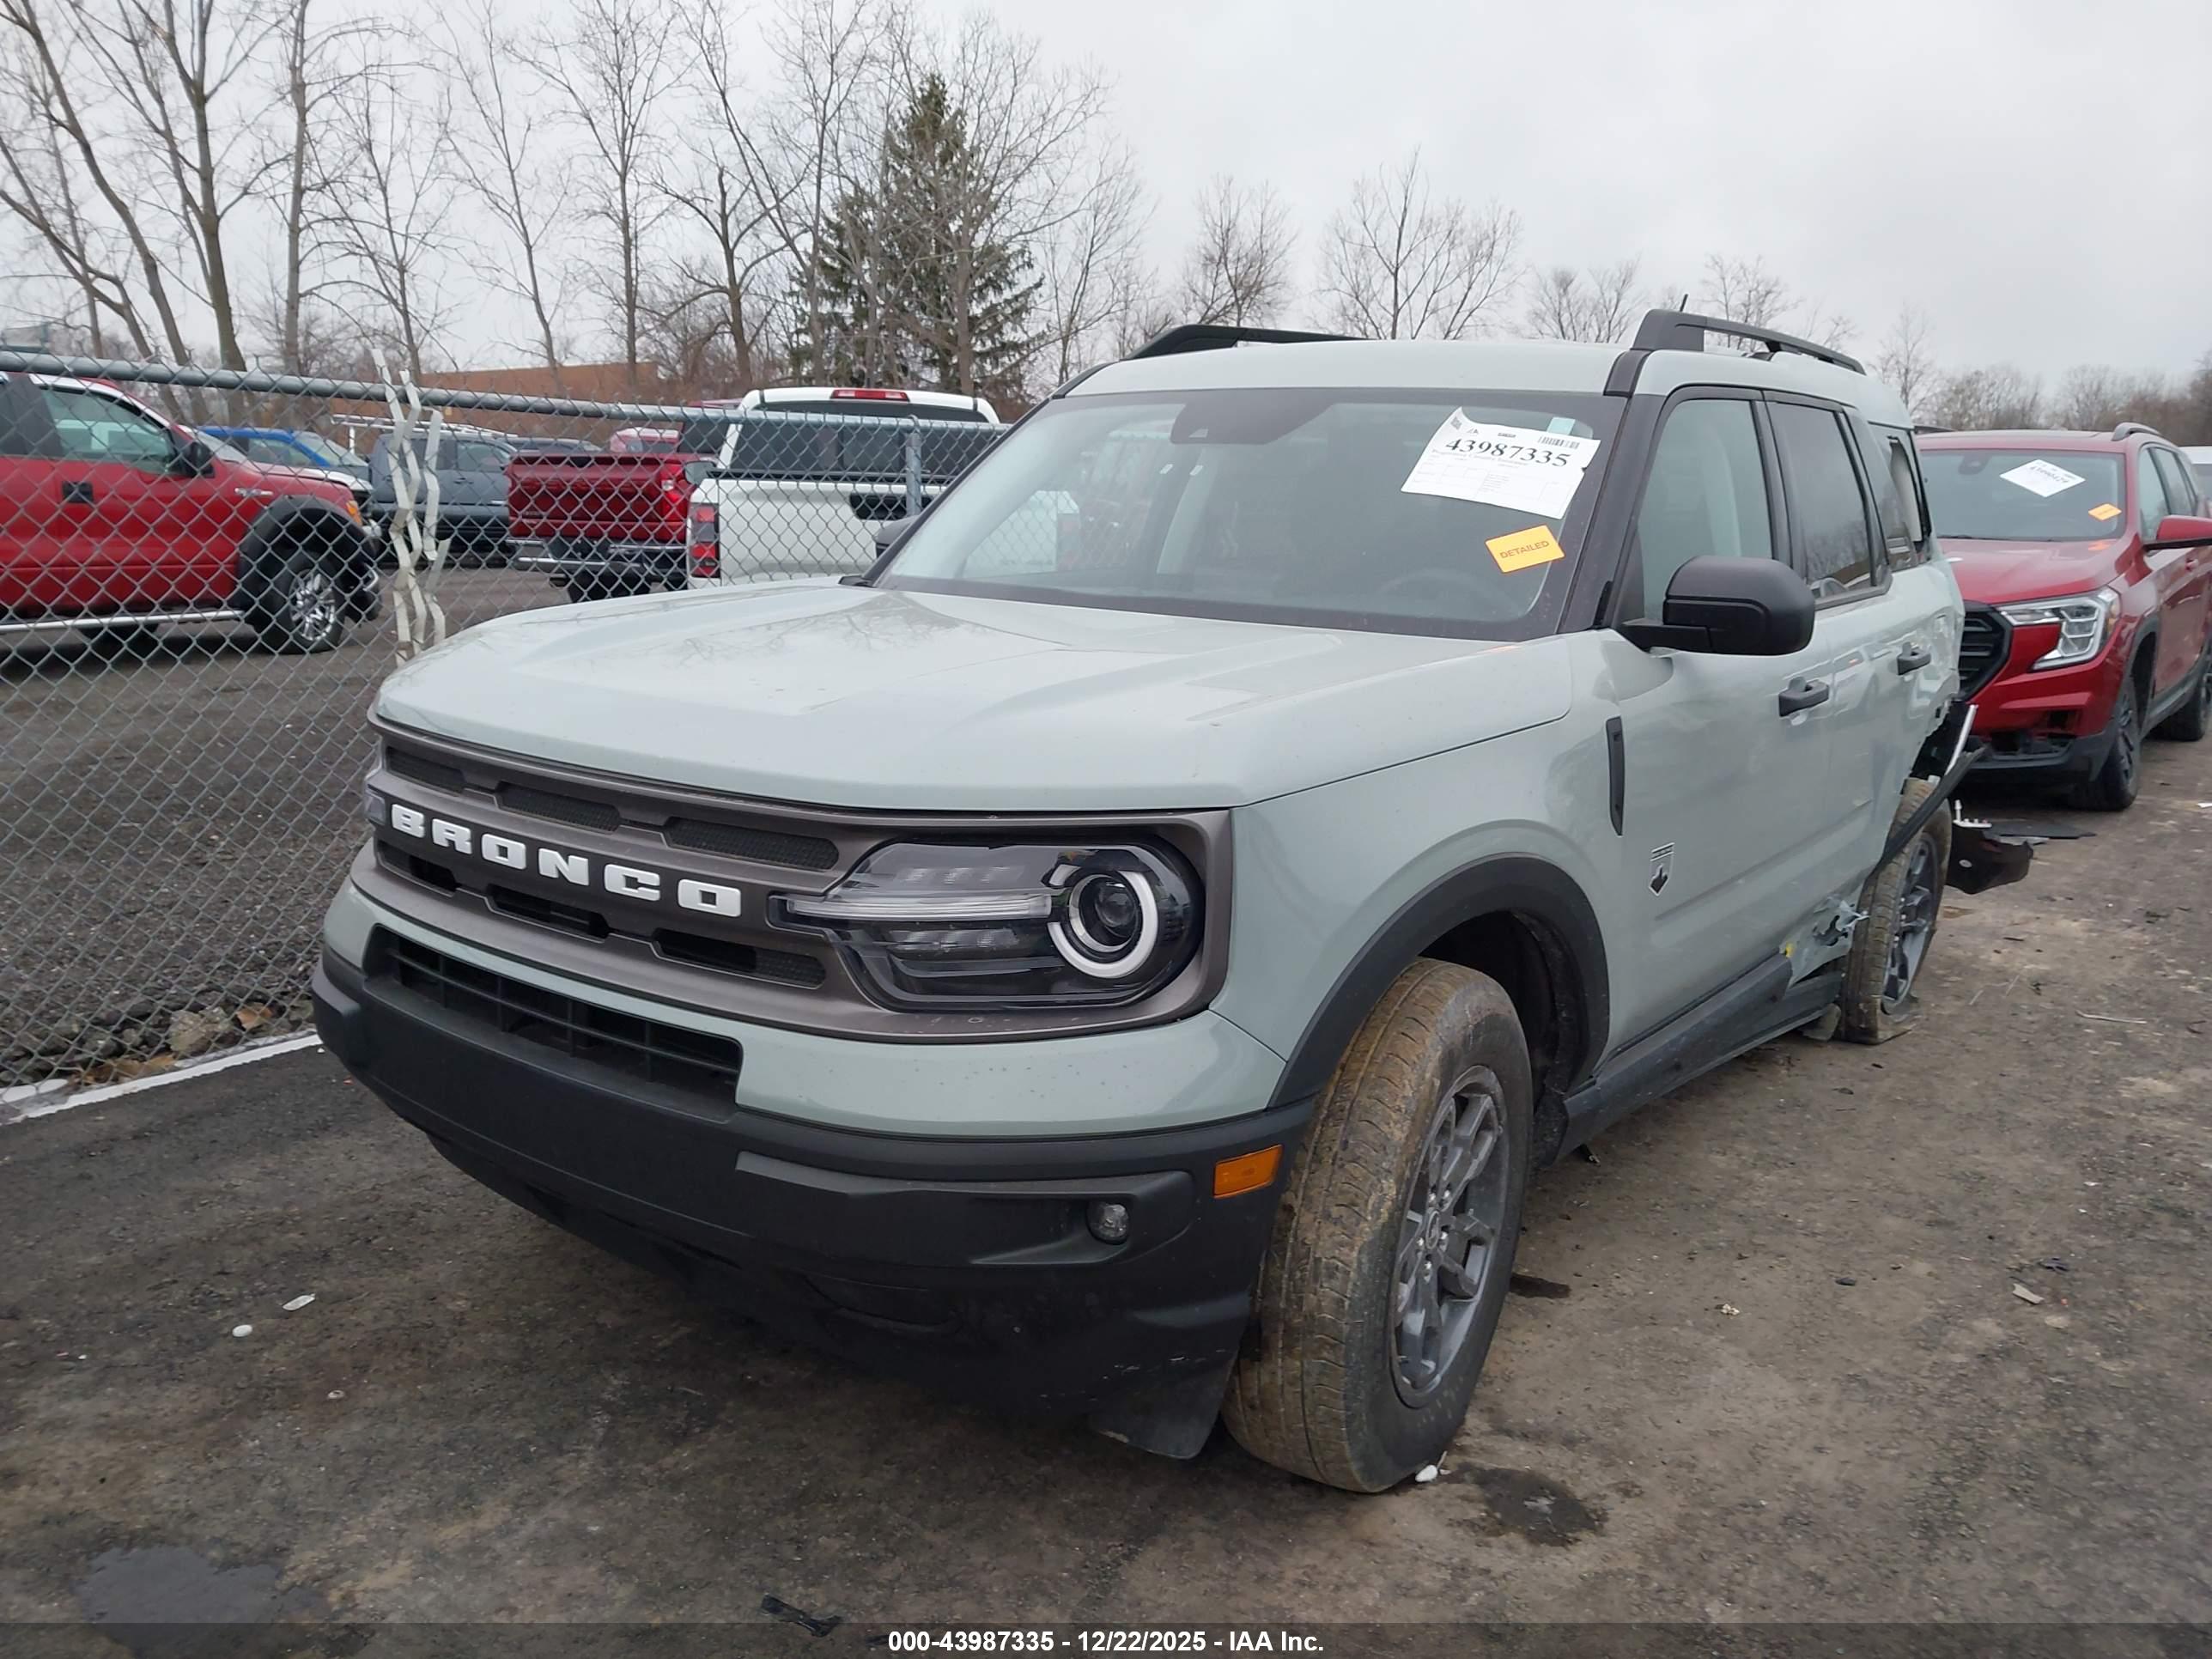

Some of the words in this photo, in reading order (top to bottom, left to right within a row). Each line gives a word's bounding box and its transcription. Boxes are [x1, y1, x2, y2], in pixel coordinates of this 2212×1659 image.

[1445, 438, 1571, 467] 43987335
[1500, 541, 1549, 558] DETAILED
[391, 804, 742, 917] BRONCO
